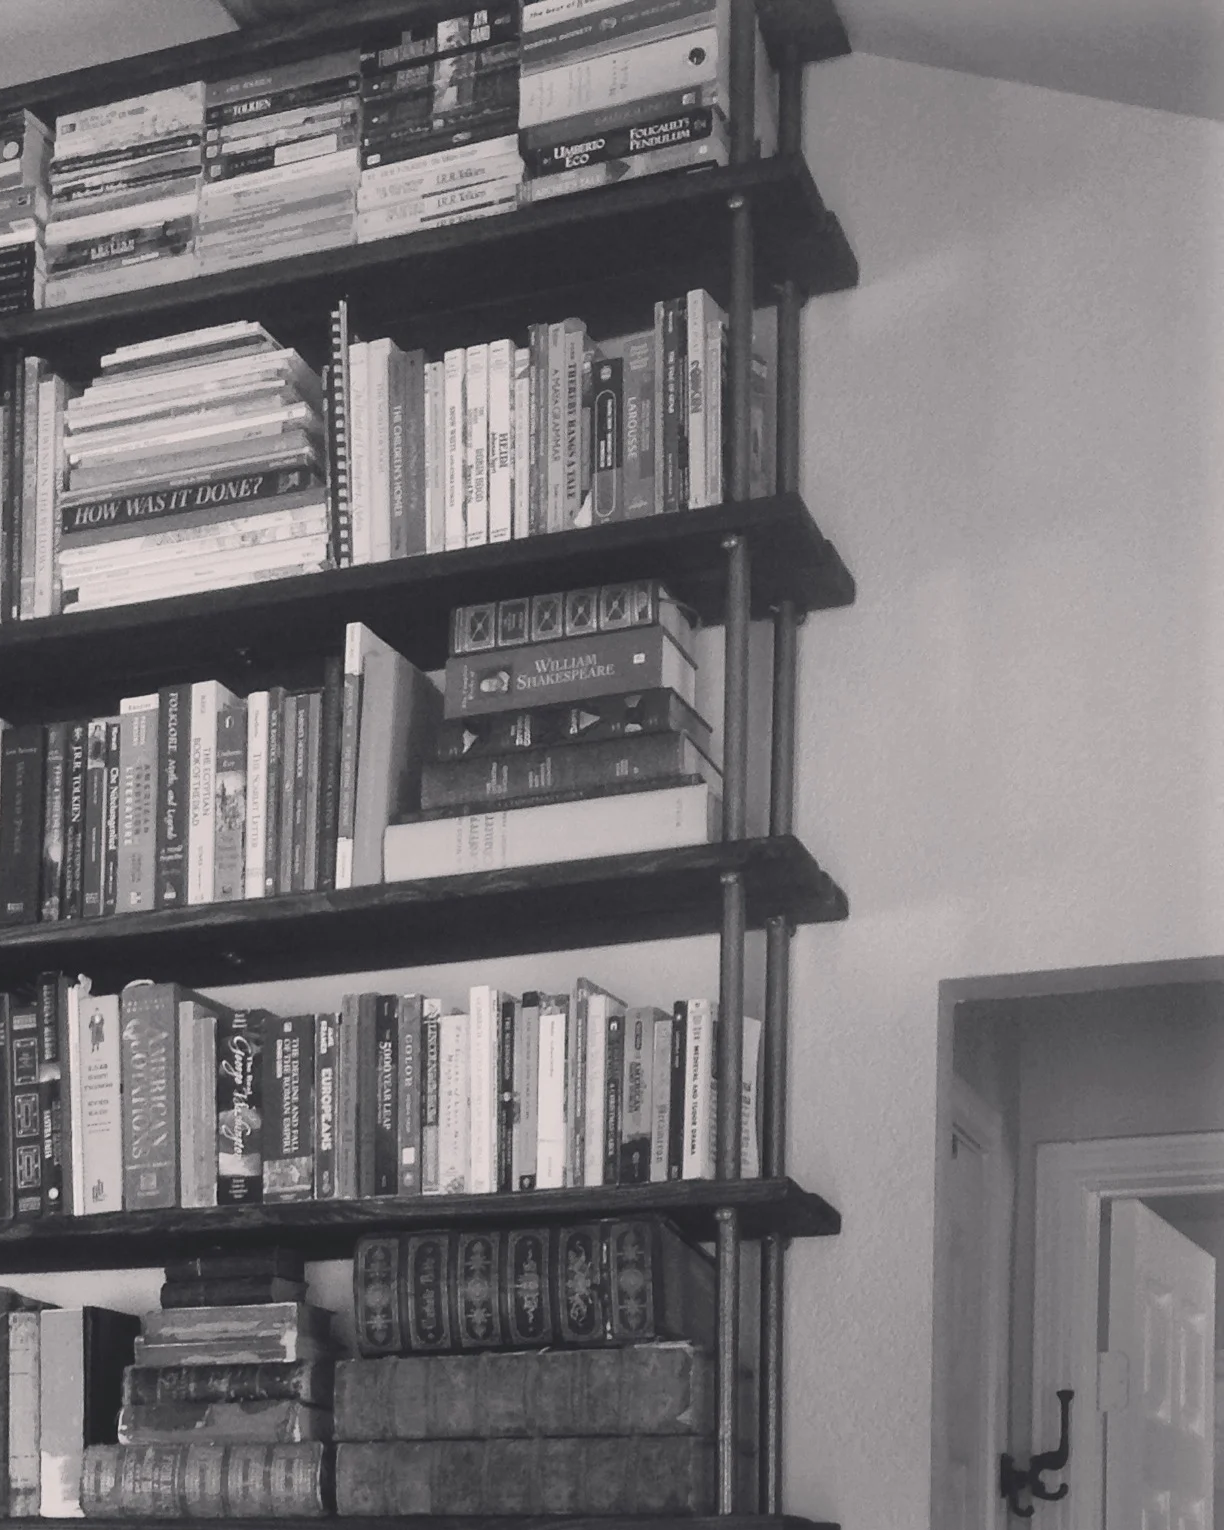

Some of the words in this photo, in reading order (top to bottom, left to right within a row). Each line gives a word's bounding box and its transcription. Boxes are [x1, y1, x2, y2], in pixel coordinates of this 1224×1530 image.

[627, 396, 638, 459] LAROUSSE
[75, 501, 121, 524] HOW
[126, 493, 166, 516] WAS
[169, 489, 192, 509] IT
[195, 477, 263, 505] DONE?
[516, 664, 615, 690] SHAKESPEARE
[534, 654, 597, 673] WILLIAM
